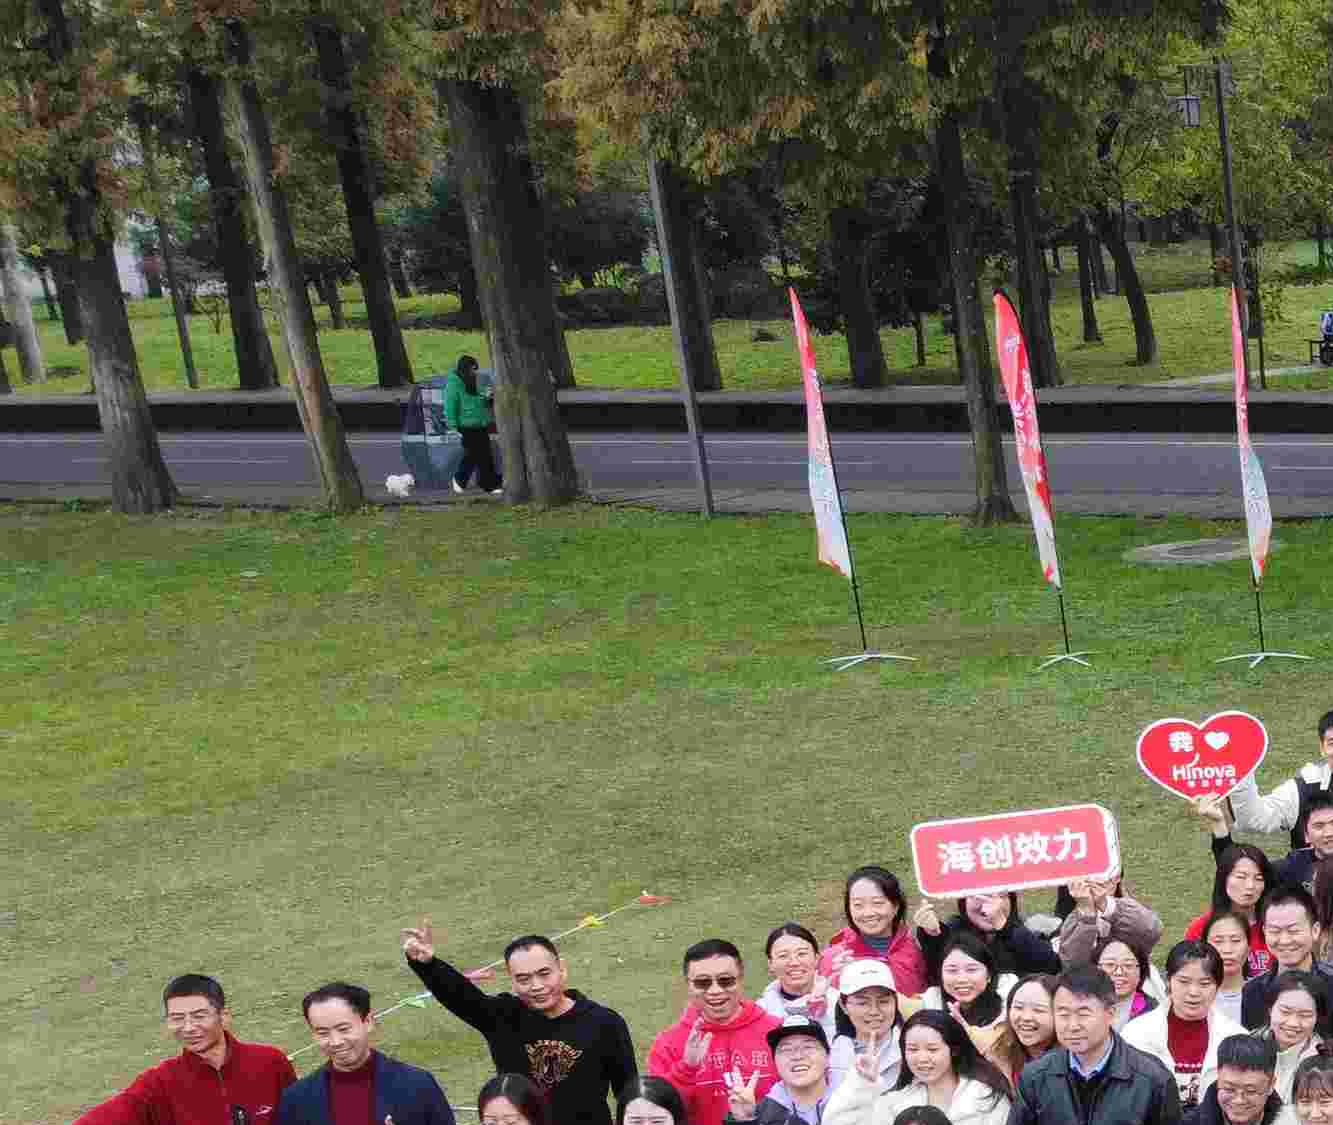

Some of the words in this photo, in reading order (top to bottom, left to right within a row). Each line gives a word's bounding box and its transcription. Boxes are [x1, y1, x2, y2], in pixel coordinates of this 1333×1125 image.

[1168, 731, 1194, 752] 我
[937, 828, 1088, 874] 海创效力
